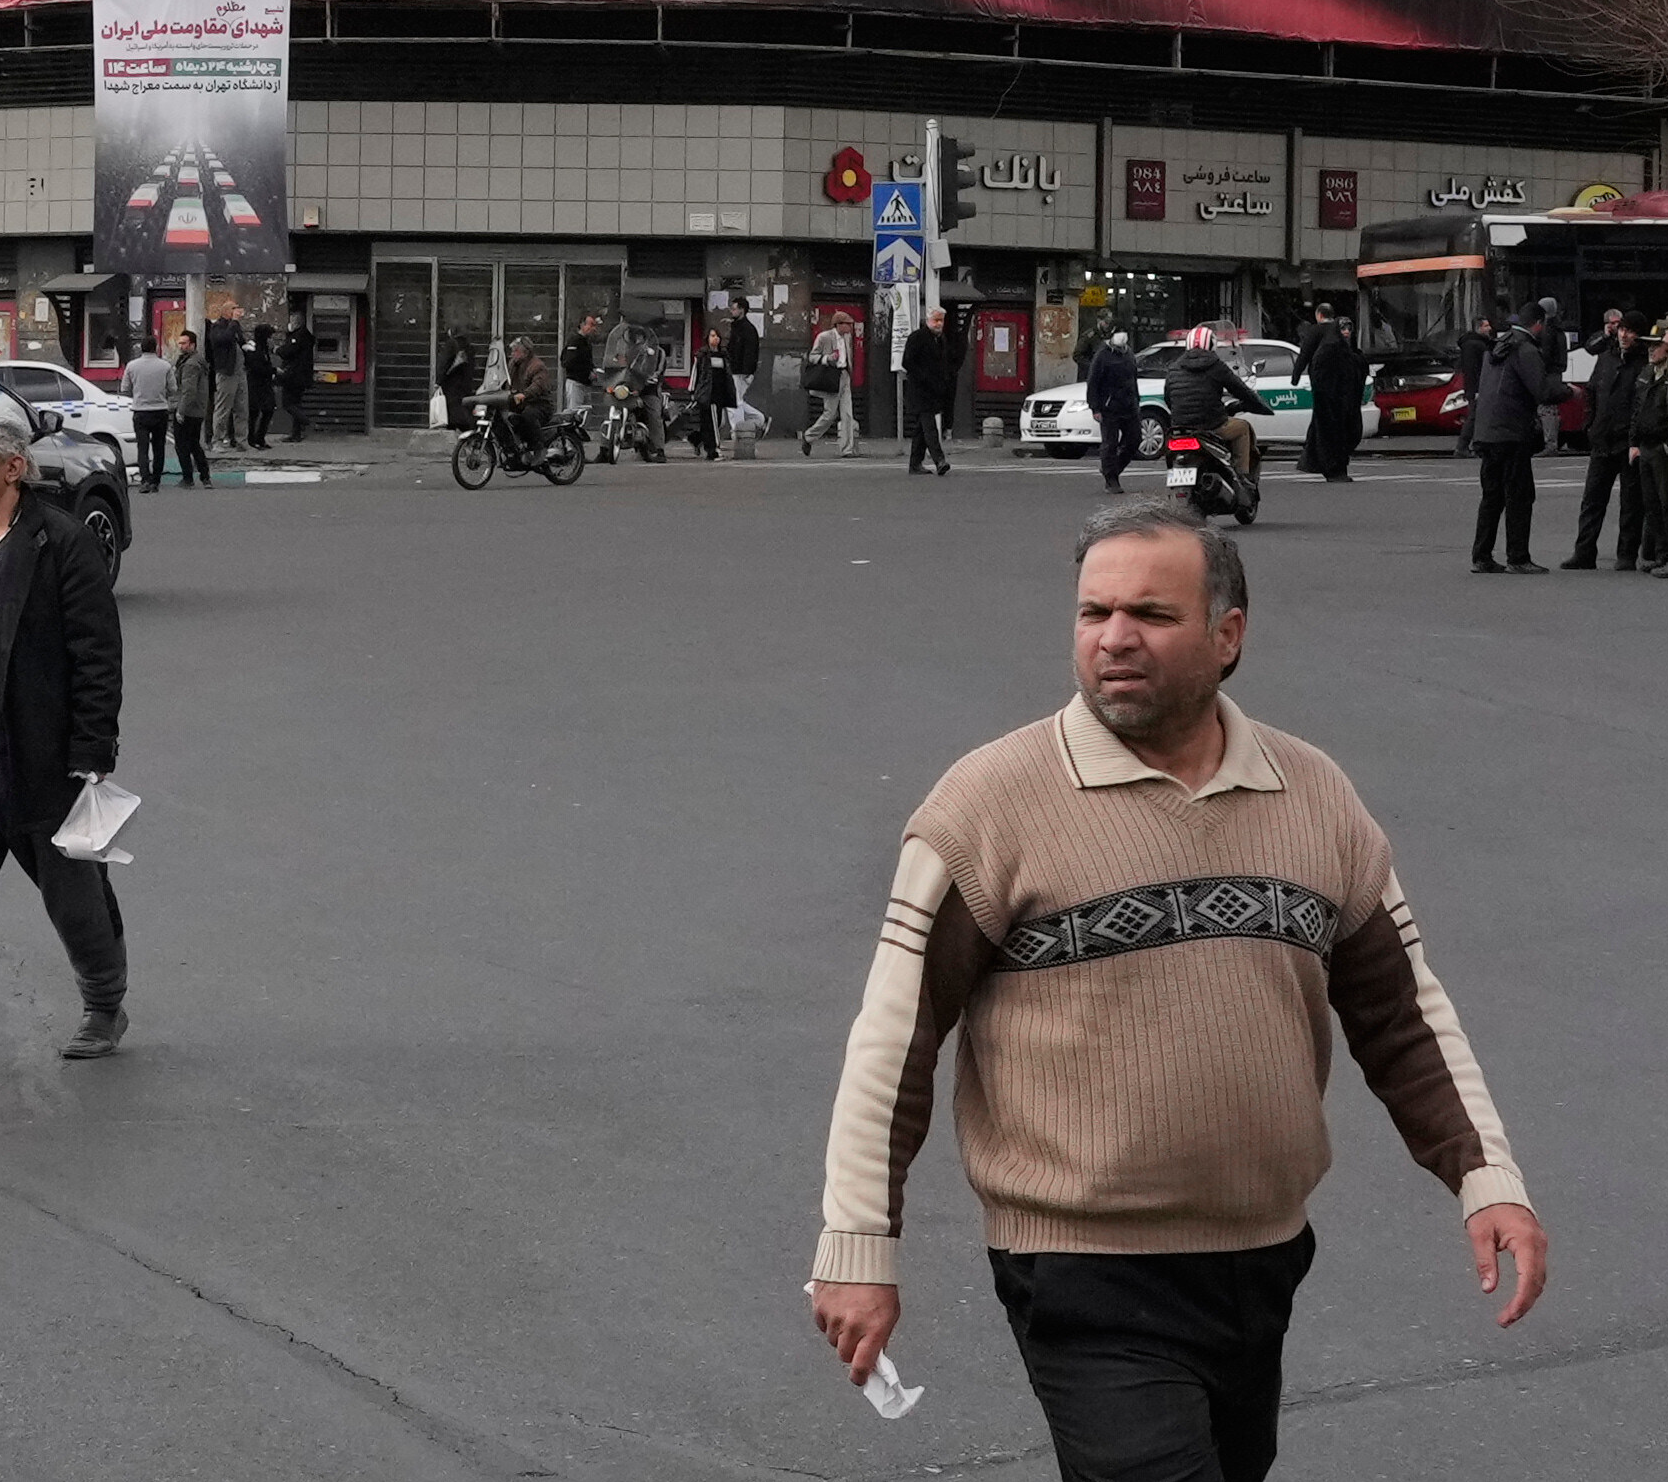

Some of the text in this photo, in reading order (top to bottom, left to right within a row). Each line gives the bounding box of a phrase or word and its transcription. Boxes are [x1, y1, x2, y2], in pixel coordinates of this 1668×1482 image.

[216, 0, 246, 17] مظلوم
[101, 17, 283, 41] شهدای مقاومت ملی ایران
[107, 61, 166, 74] ساعت ۱۴
[226, 60, 277, 76] چهارشنبه
[104, 80, 130, 92] شهدا
[132, 80, 160, 95] معراج
[162, 80, 191, 91] سمت
[193, 82, 204, 93] به
[206, 80, 231, 93] تهران
[233, 78, 273, 91] دانشگاه
[1132, 166, 1162, 180] 984
[1182, 166, 1271, 186] ساعت فروشی
[1325, 176, 1355, 190] 986
[1429, 175, 1527, 209] کفش ملی
[1198, 191, 1274, 221] ساعتی
[1268, 392, 1298, 410] پلیس
